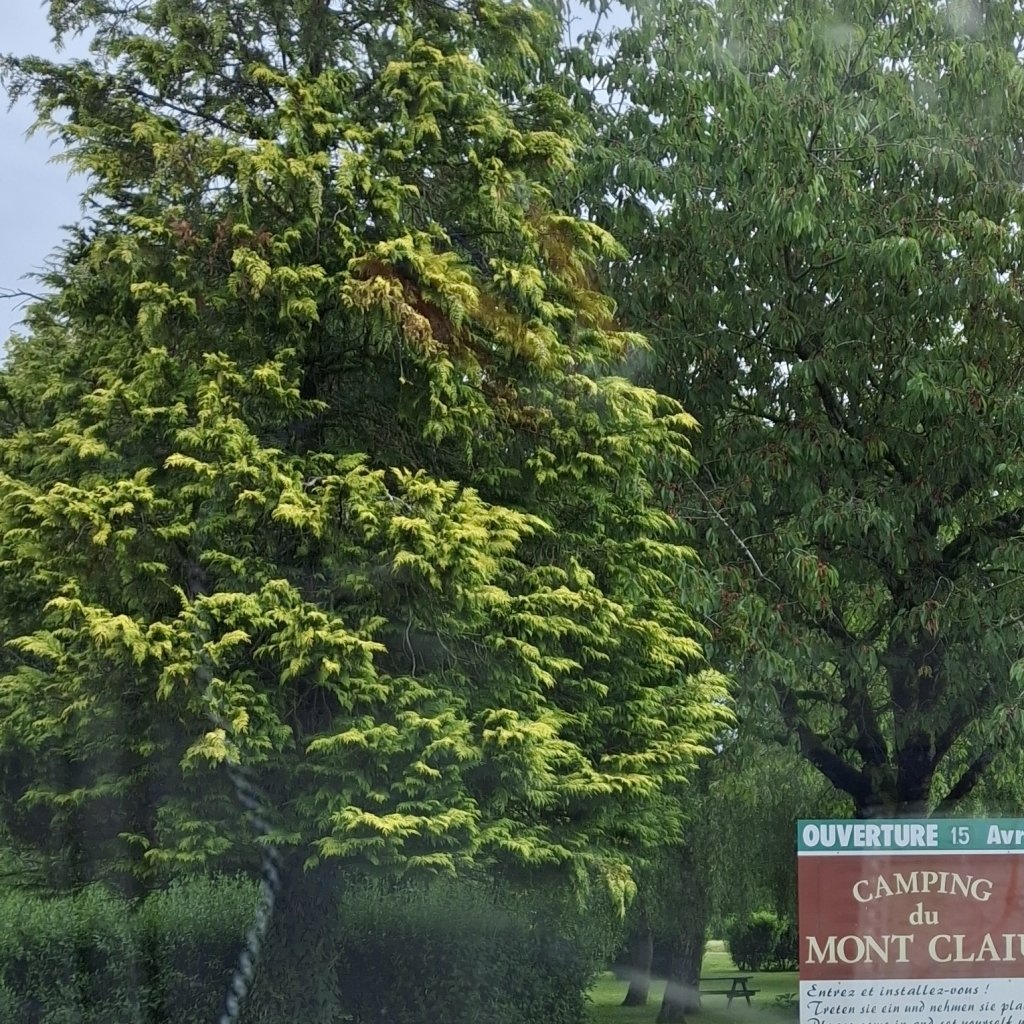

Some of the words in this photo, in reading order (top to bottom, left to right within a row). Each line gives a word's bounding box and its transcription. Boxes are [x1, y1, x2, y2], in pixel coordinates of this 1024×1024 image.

[802, 823, 938, 847] OUVERTURE
[951, 826, 970, 845] 15
[852, 871, 993, 903] CAMPING
[908, 902, 939, 925] du
[805, 934, 914, 964] MONT
[806, 984, 855, 998] Entrez
[861, 987, 874, 997] et
[880, 985, 979, 996] installez-vous
[807, 1001, 855, 1016] Treten
[860, 1004, 877, 1014] sie
[881, 1004, 900, 1013] ein
[904, 1001, 925, 1013] und
[930, 1000, 975, 1013] nehmen
[980, 1002, 997, 1012] sie
